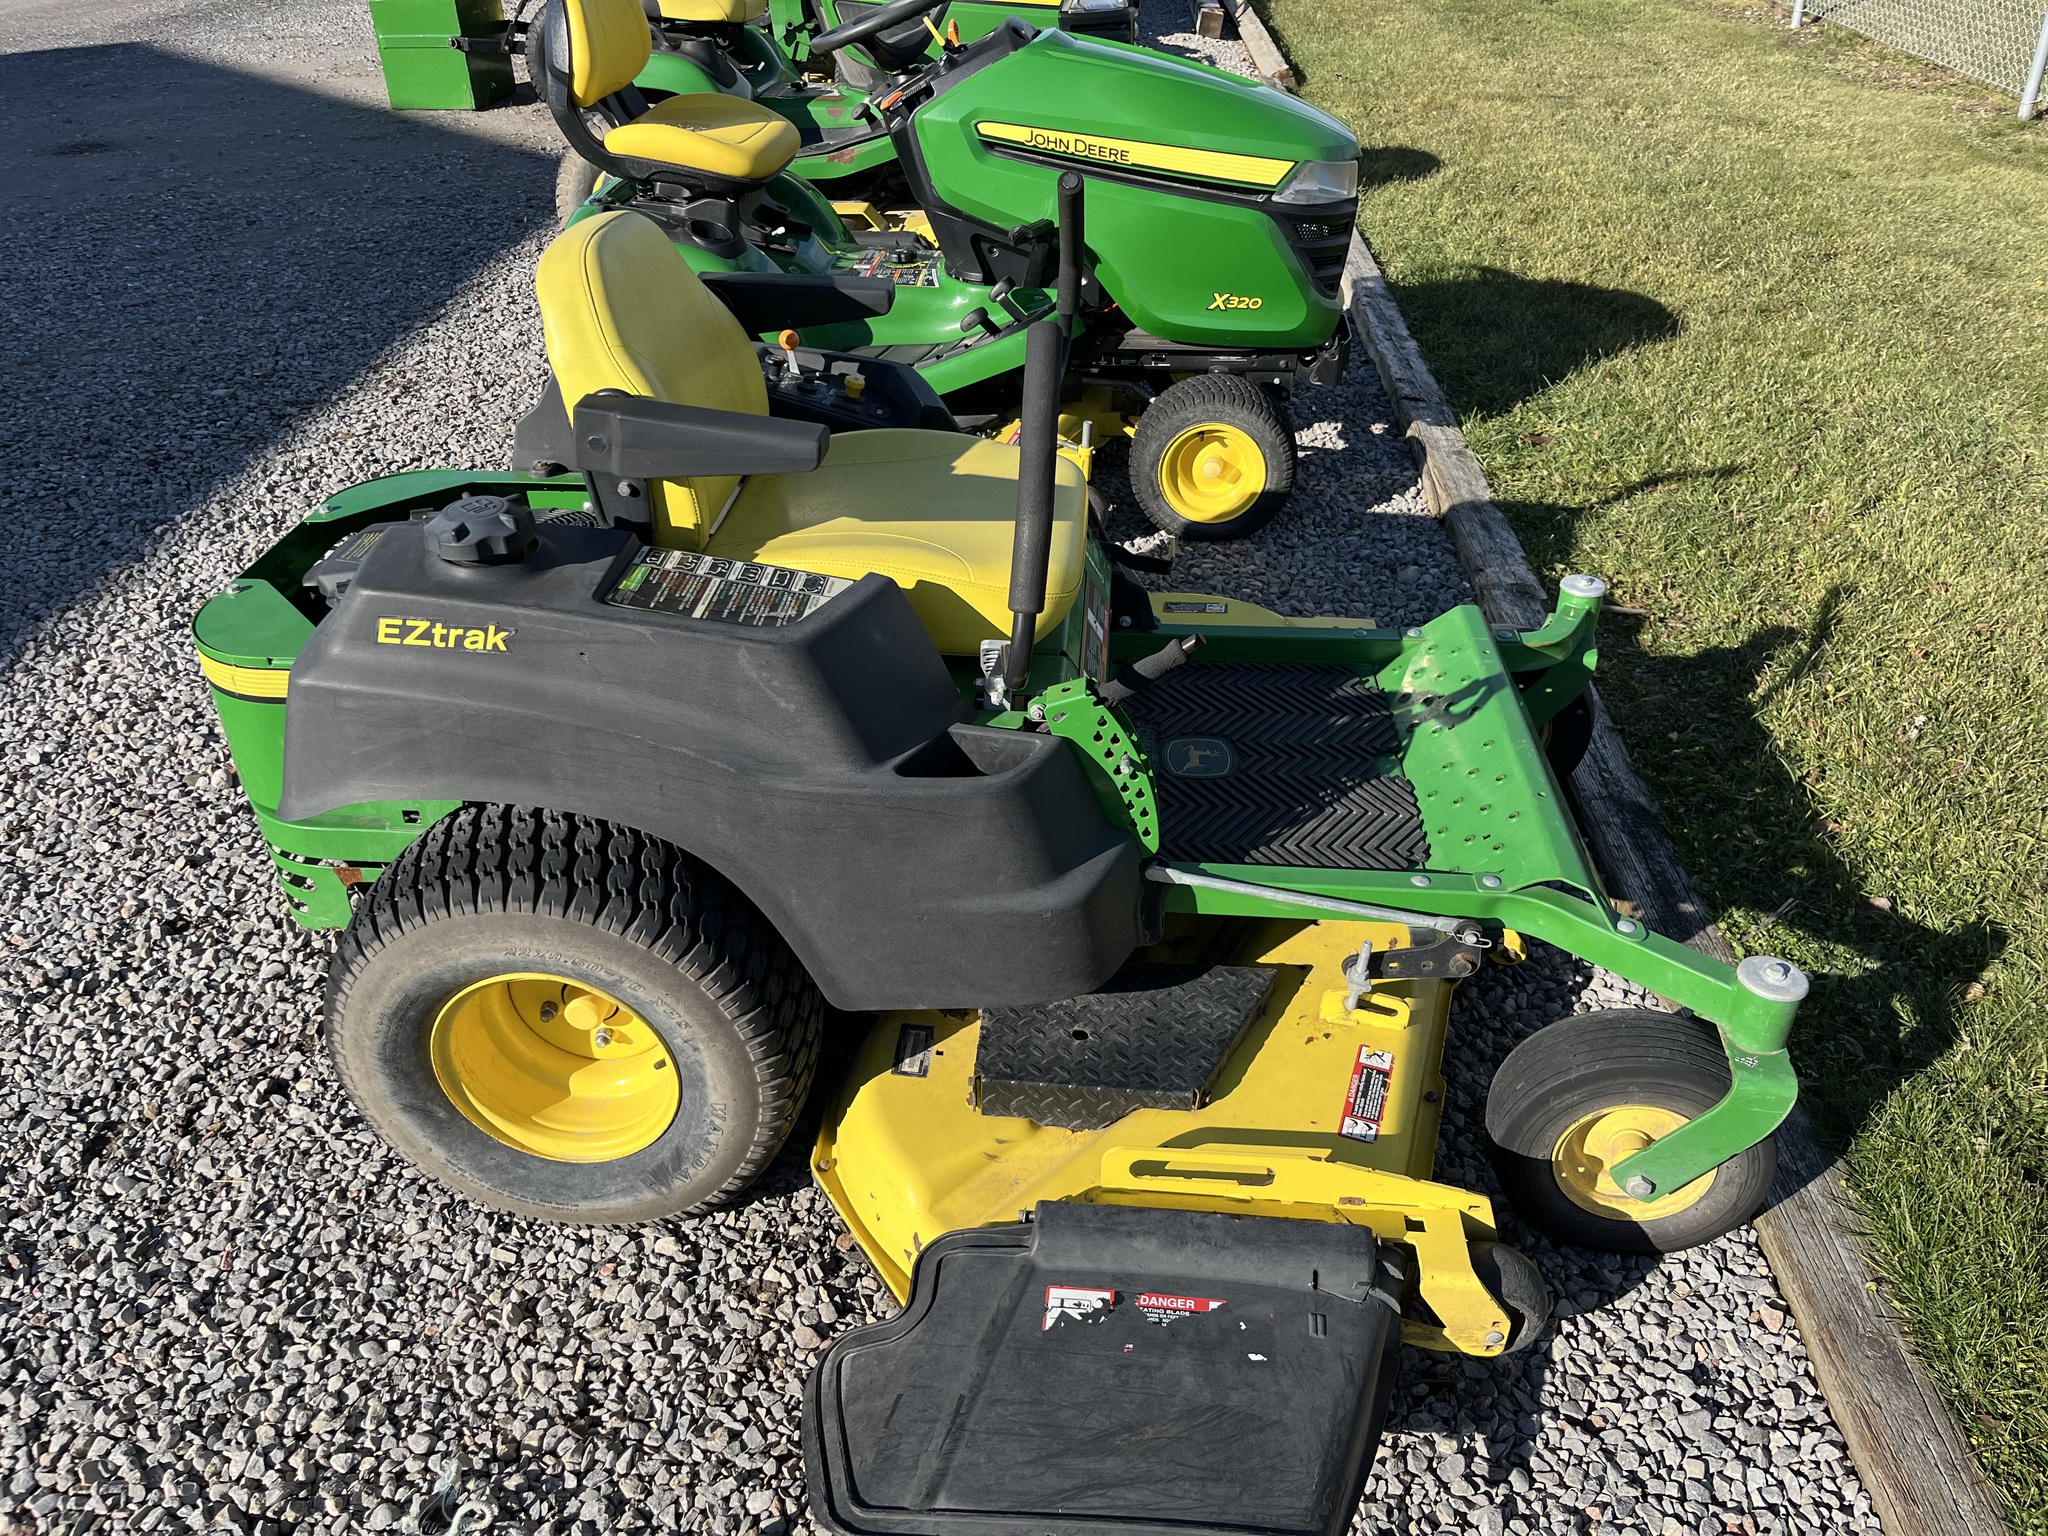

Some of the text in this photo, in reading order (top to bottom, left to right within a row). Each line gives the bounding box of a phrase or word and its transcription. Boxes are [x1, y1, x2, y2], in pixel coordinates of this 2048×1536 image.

[1024, 128, 1131, 162] JOHN DEERE
[1207, 292, 1264, 312] X320
[376, 617, 510, 653] EZtrak
[1347, 1073, 1360, 1100] DANGER
[674, 1102, 727, 1184] WANDA
[1140, 1295, 1195, 1310] DANGER
[1166, 1309, 1190, 1317] BLADE
